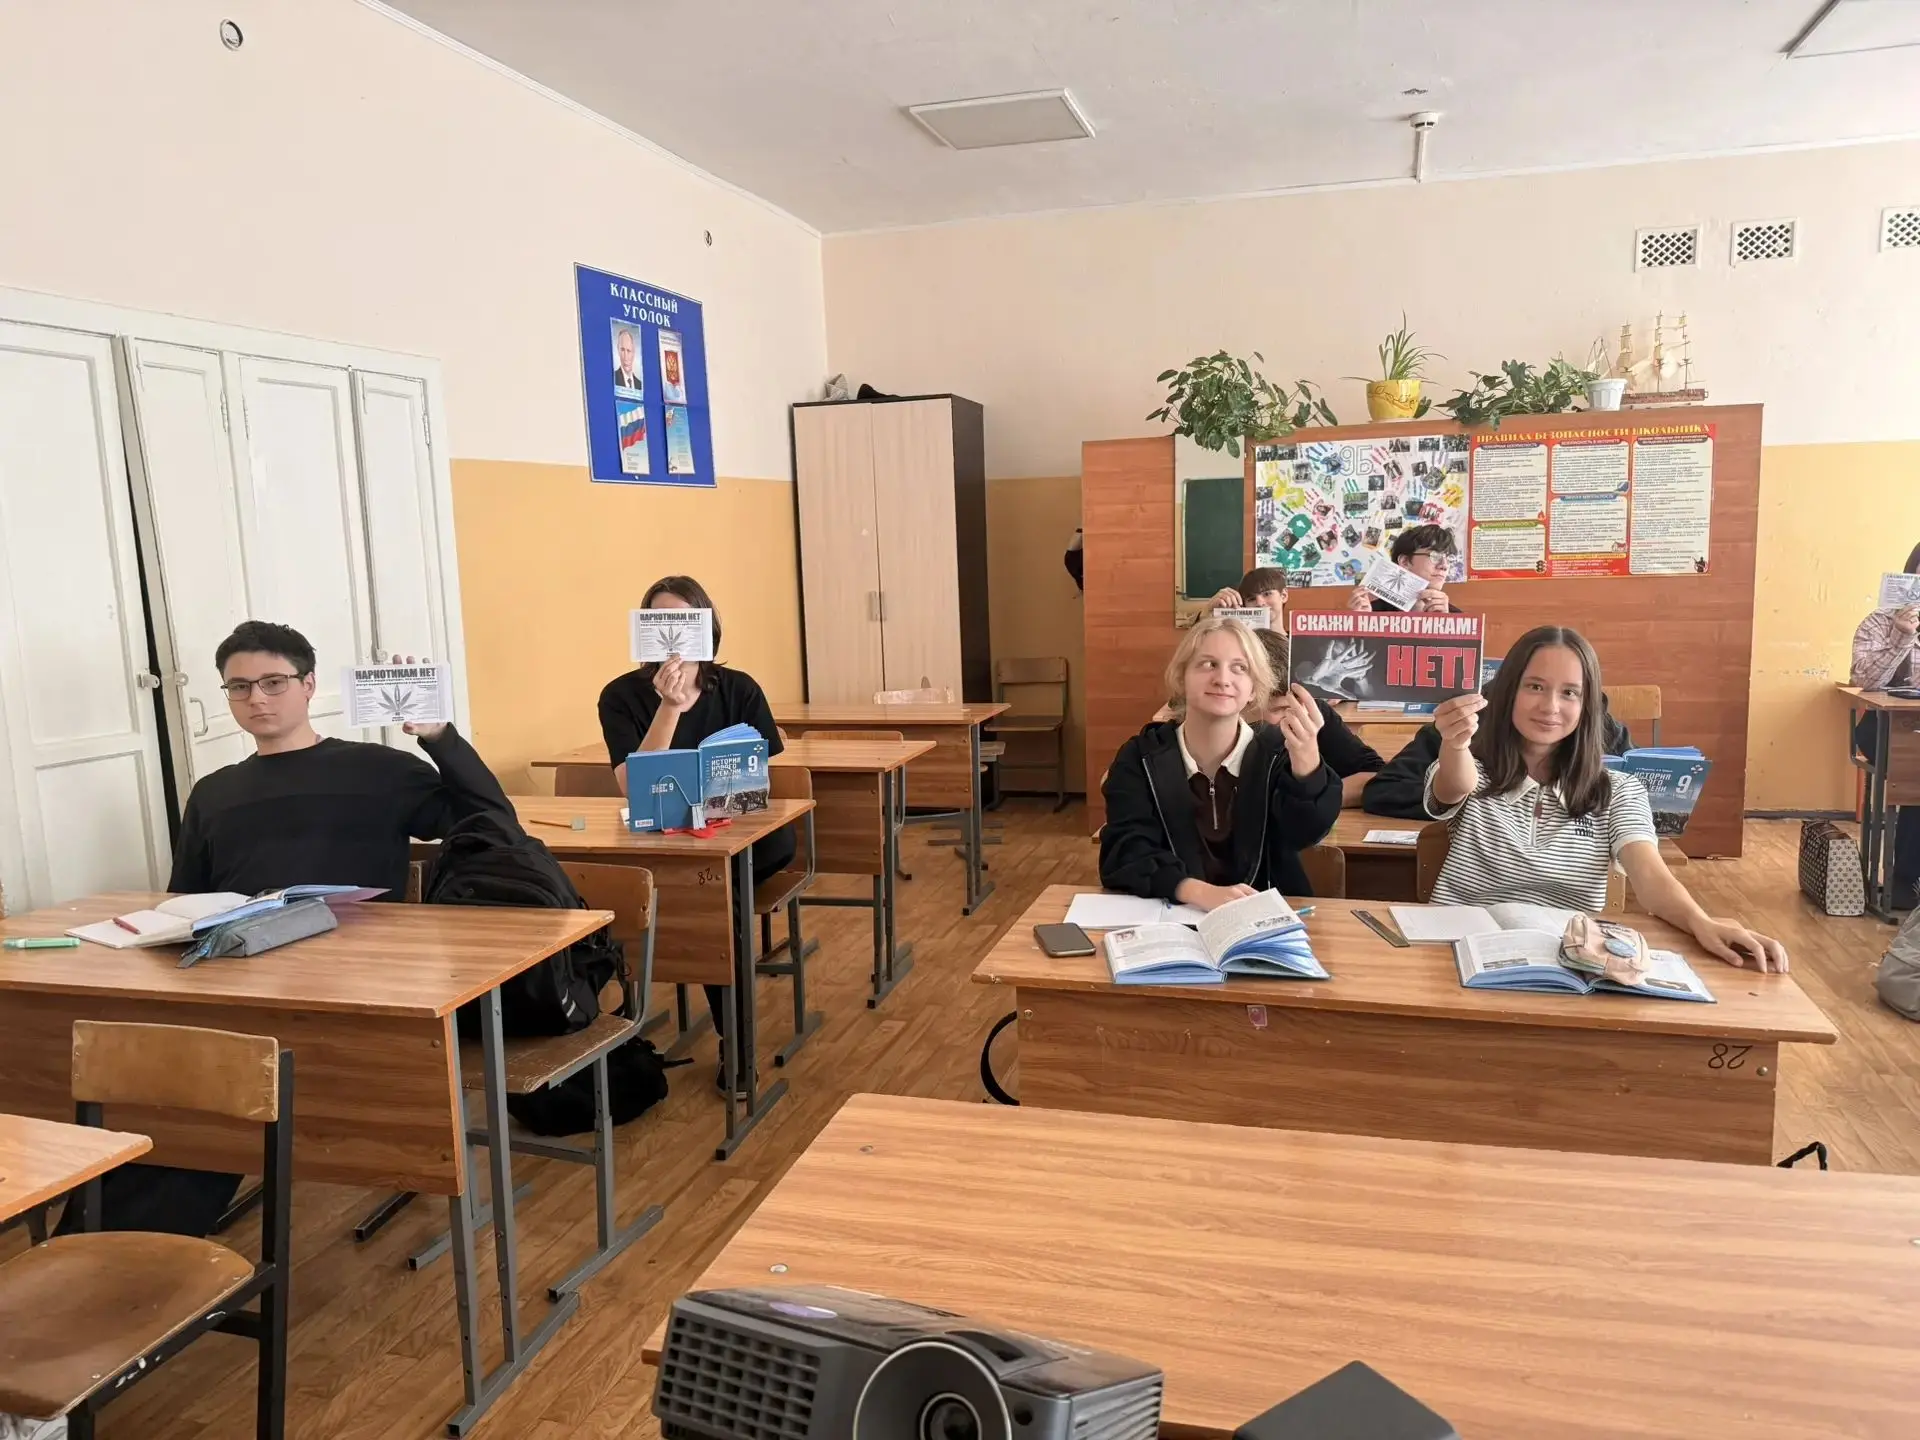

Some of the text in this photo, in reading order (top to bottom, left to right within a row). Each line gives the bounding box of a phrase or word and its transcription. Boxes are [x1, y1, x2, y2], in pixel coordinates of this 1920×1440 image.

[610, 283, 678, 314] КЛАССНЫЙ
[623, 304, 671, 327] УГОЛОК
[1476, 433, 1532, 443] ПРАВИЛА
[1632, 423, 1709, 436] ШКОЛЬНИКА
[1340, 444, 1374, 476] 9Б
[688, 612, 701, 620] НЕТ
[1296, 614, 1478, 635] СКАЖИ НАРКОТИКАМ!
[355, 667, 436, 680] НАРКОТИКАМ НЕТ
[1386, 644, 1477, 690] НЕТ!
[748, 755, 759, 772] 9
[1676, 775, 1692, 794] 9
